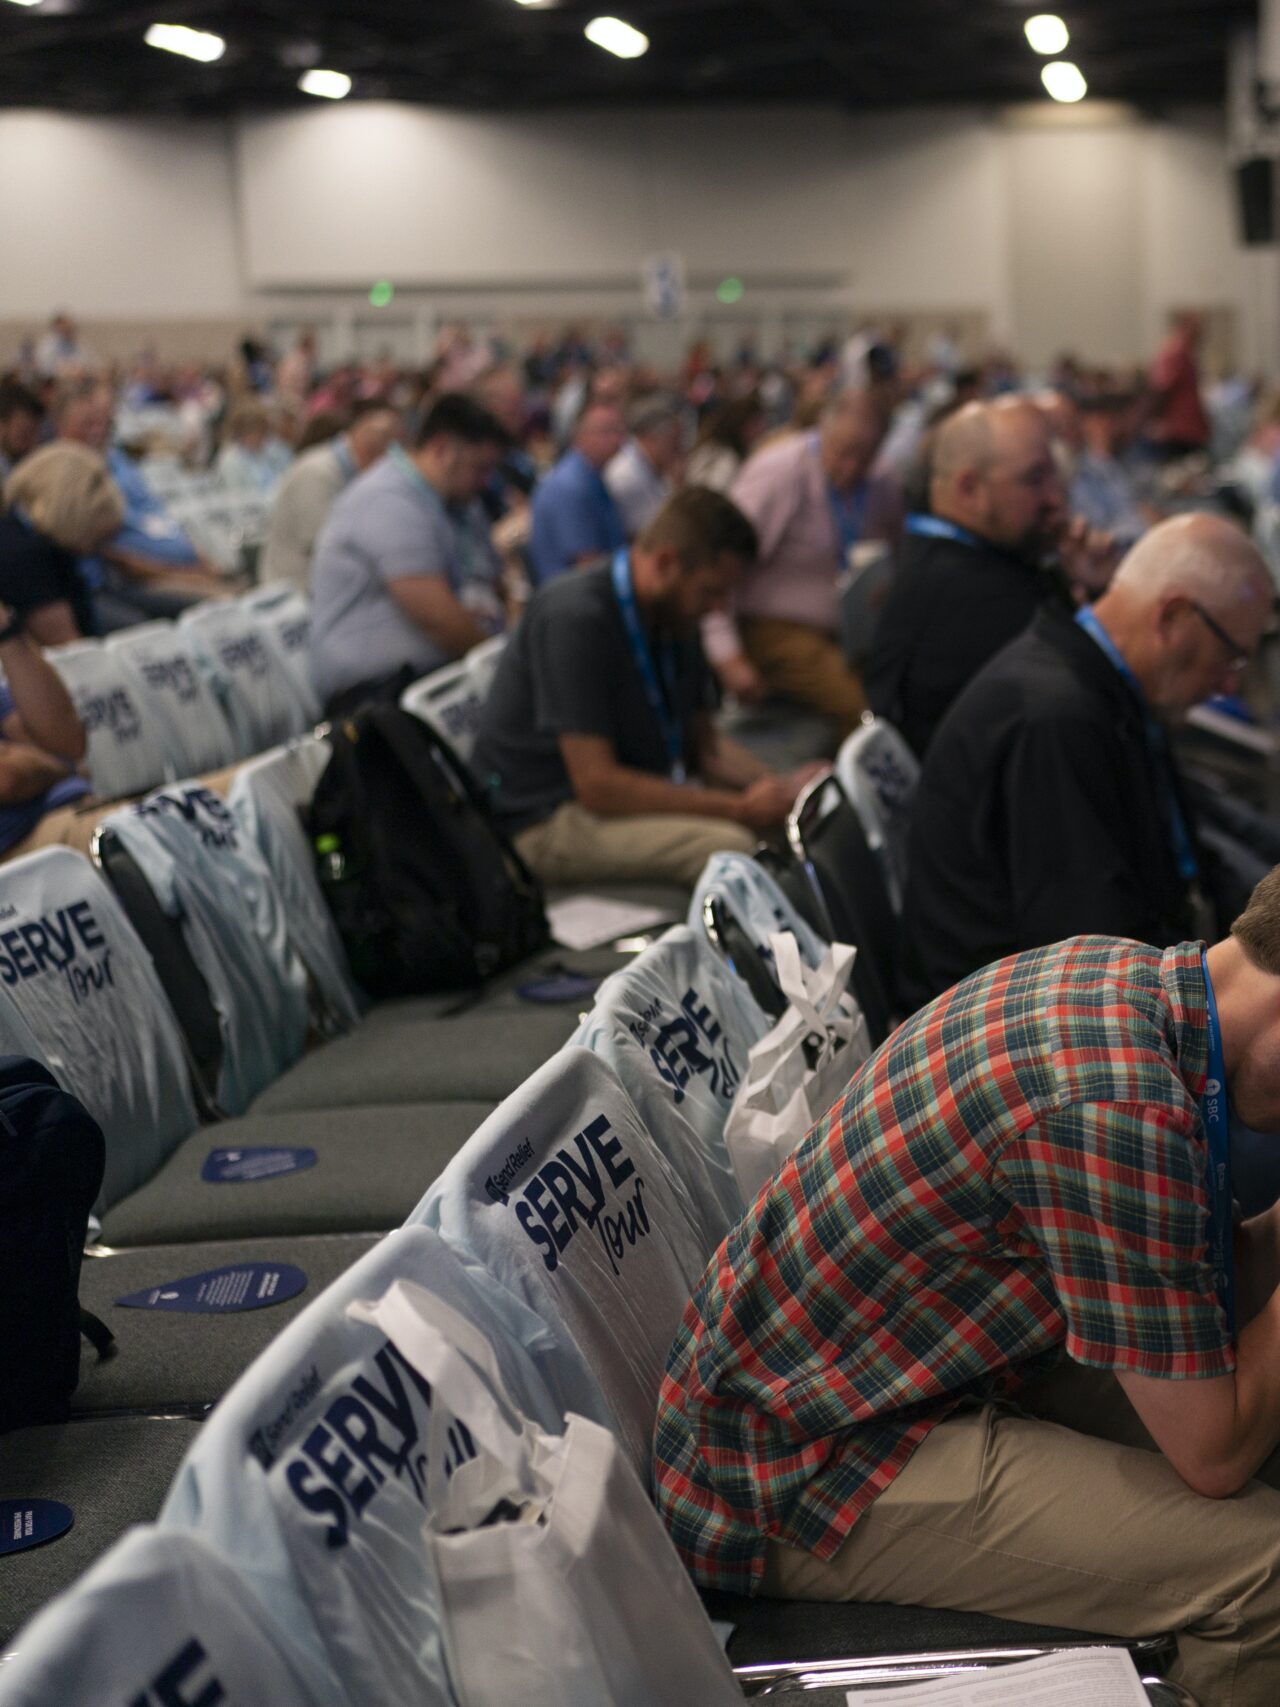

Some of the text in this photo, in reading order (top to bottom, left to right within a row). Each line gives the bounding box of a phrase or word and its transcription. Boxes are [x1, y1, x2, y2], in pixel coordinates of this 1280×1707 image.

[0, 901, 105, 985] SERVE
[650, 987, 722, 1104] SERE
[1207, 1098, 1219, 1123] SBC
[493, 1136, 535, 1191] Send Relief
[515, 1114, 636, 1271] SERVE
[587, 1177, 650, 1276] Tour
